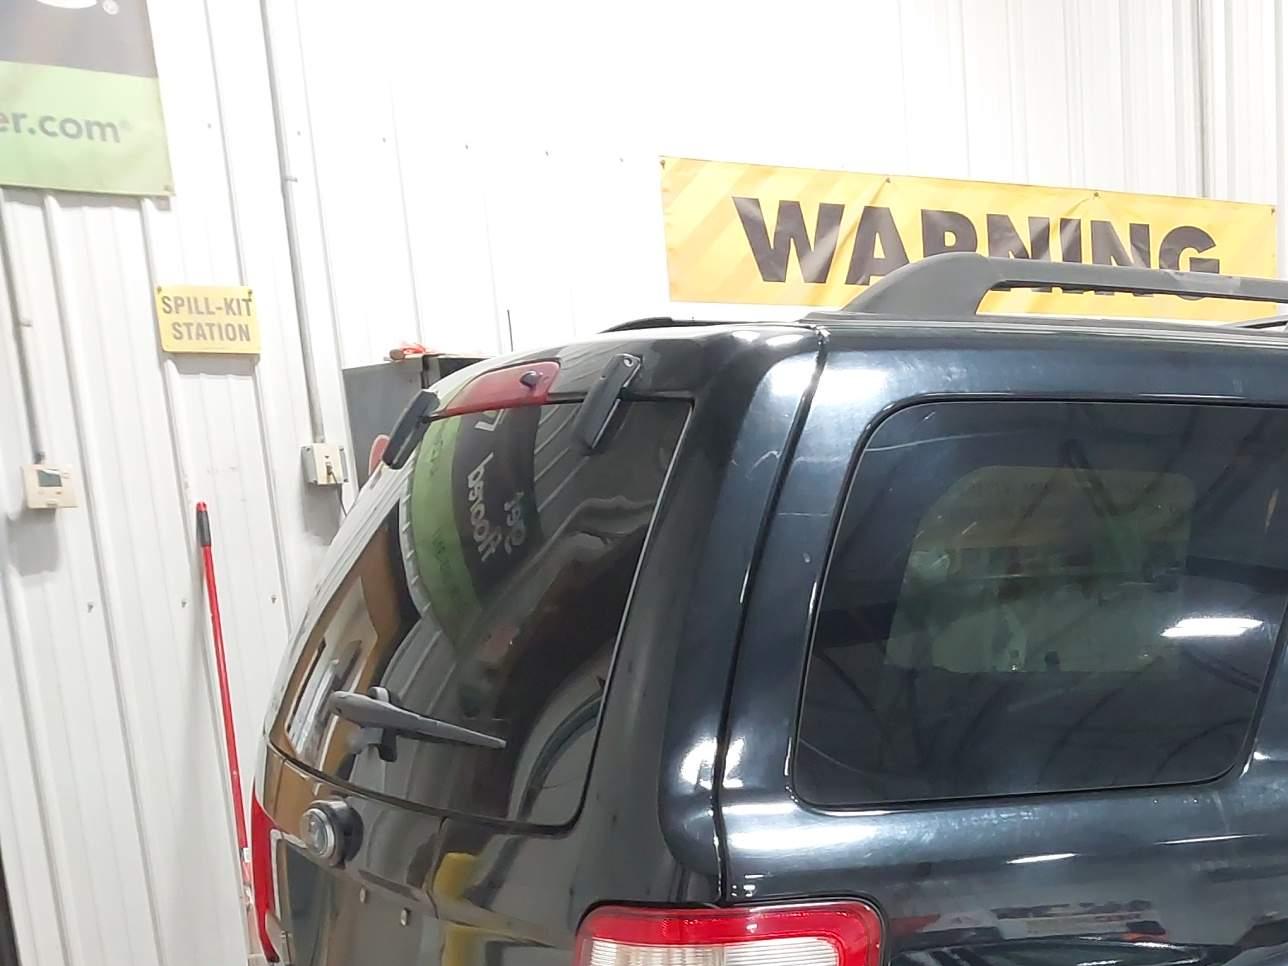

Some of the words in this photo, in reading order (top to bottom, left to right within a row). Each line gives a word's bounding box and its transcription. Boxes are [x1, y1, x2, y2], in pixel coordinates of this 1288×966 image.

[731, 195, 1221, 301] WARNING
[161, 295, 253, 316] SPILL-KIT
[171, 322, 251, 342] STATION
